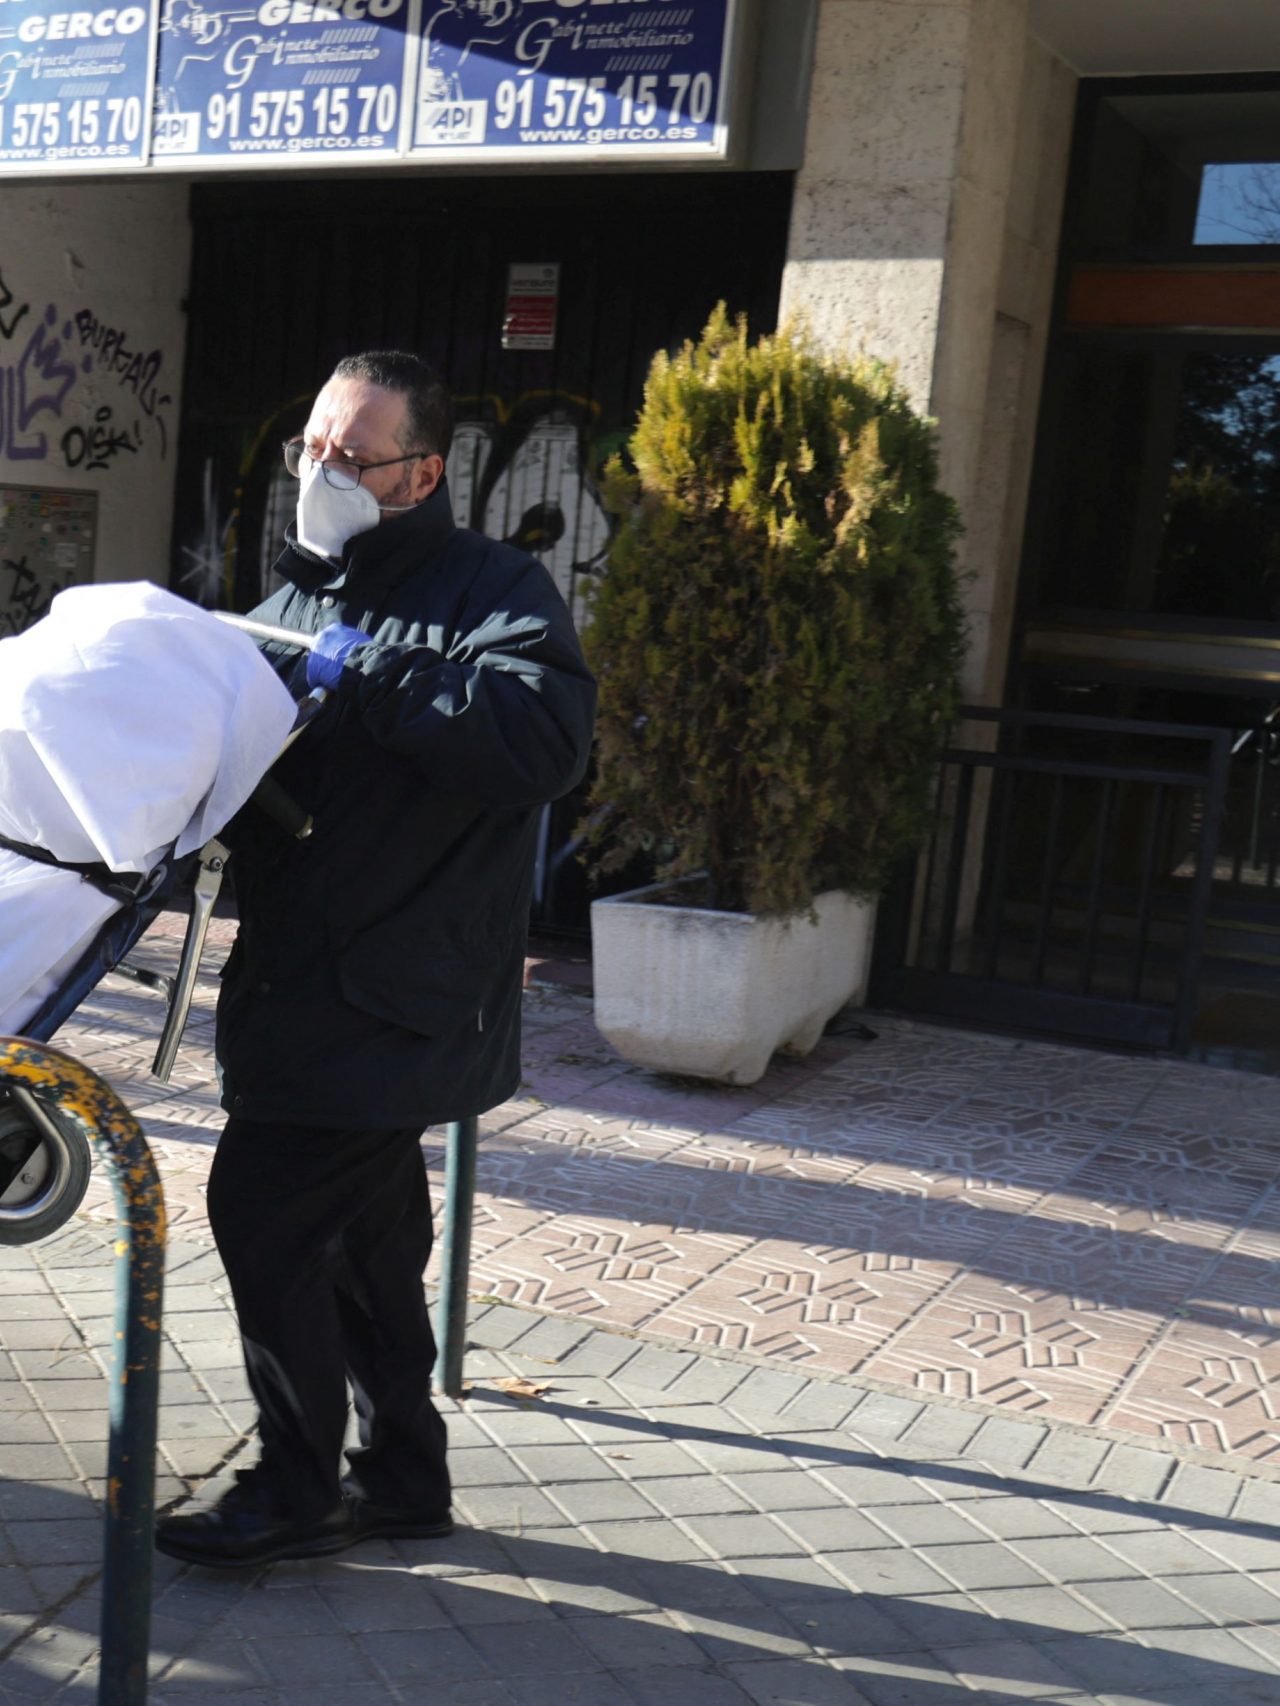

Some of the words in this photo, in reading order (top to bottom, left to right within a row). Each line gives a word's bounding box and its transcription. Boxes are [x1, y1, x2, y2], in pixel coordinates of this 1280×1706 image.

[18, 7, 146, 42] GERCO
[258, 0, 402, 26] GERCO
[207, 92, 242, 139] 91
[249, 90, 305, 138] 575
[312, 86, 350, 135] 15
[357, 84, 397, 133] 70
[494, 78, 533, 129] 91
[543, 77, 607, 128] 575
[617, 75, 658, 125] 15
[668, 72, 713, 123] 70
[12, 102, 60, 147] 575
[68, 99, 99, 144] 15
[107, 96, 142, 143] 70
[156, 118, 188, 137] API
[432, 107, 473, 129] API
[228, 134, 384, 152] www.gerco.es
[519, 126, 698, 144] www.gerco.es
